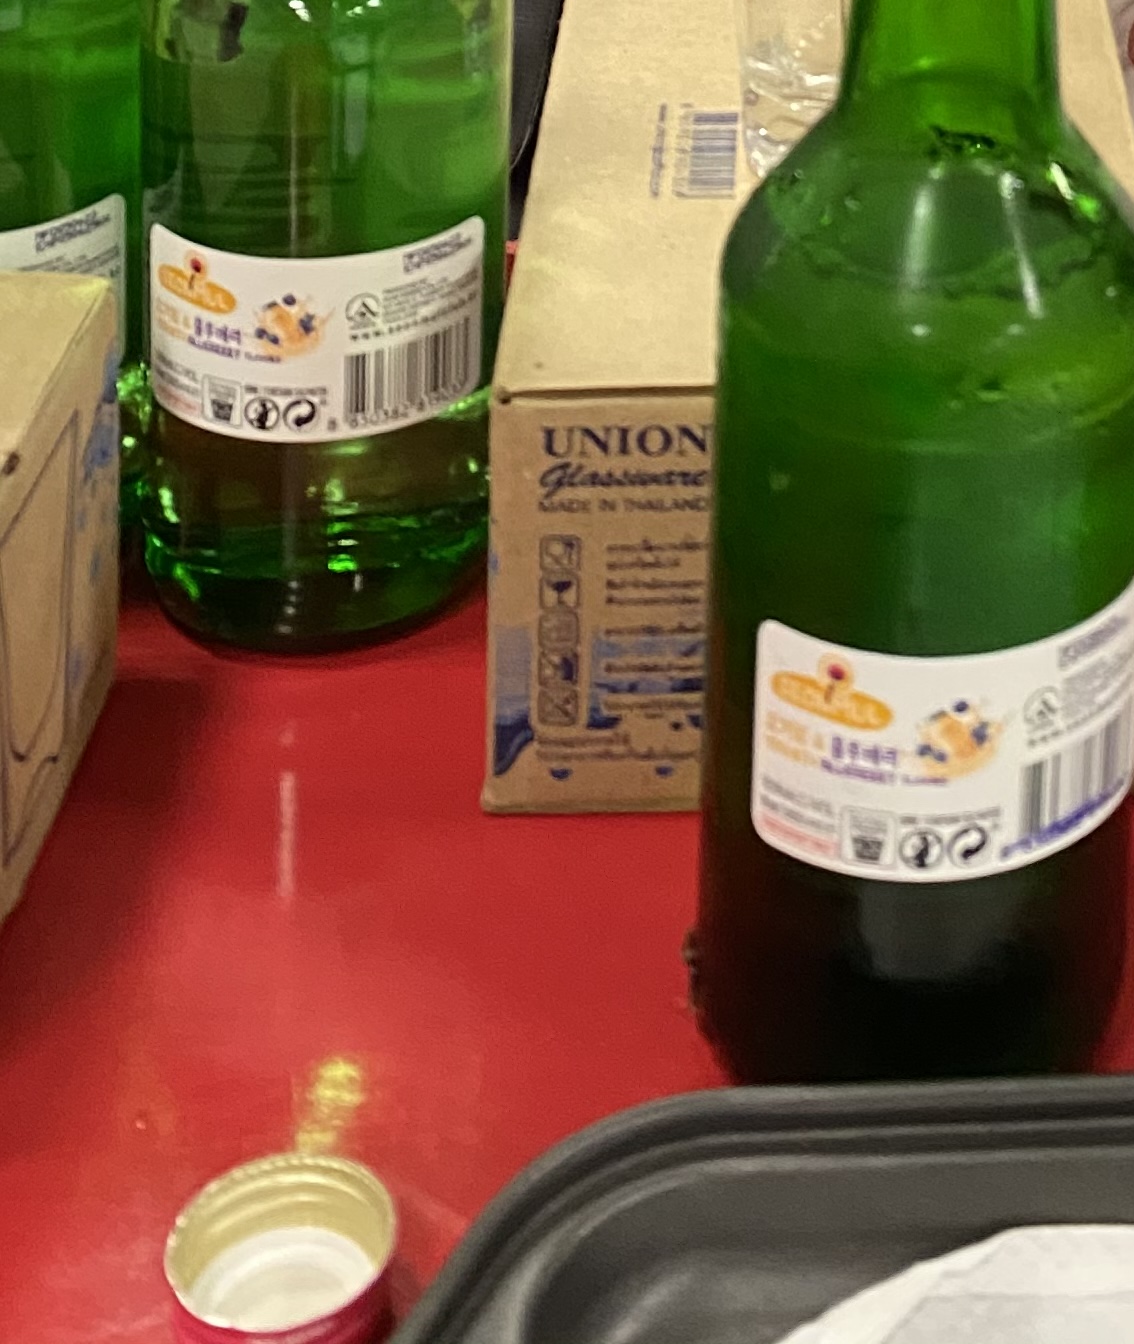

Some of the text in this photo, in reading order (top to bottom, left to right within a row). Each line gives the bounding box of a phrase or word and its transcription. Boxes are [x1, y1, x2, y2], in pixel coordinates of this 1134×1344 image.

[541, 424, 711, 458] UNION
[538, 499, 591, 512] MADE
[598, 498, 616, 511] IN
